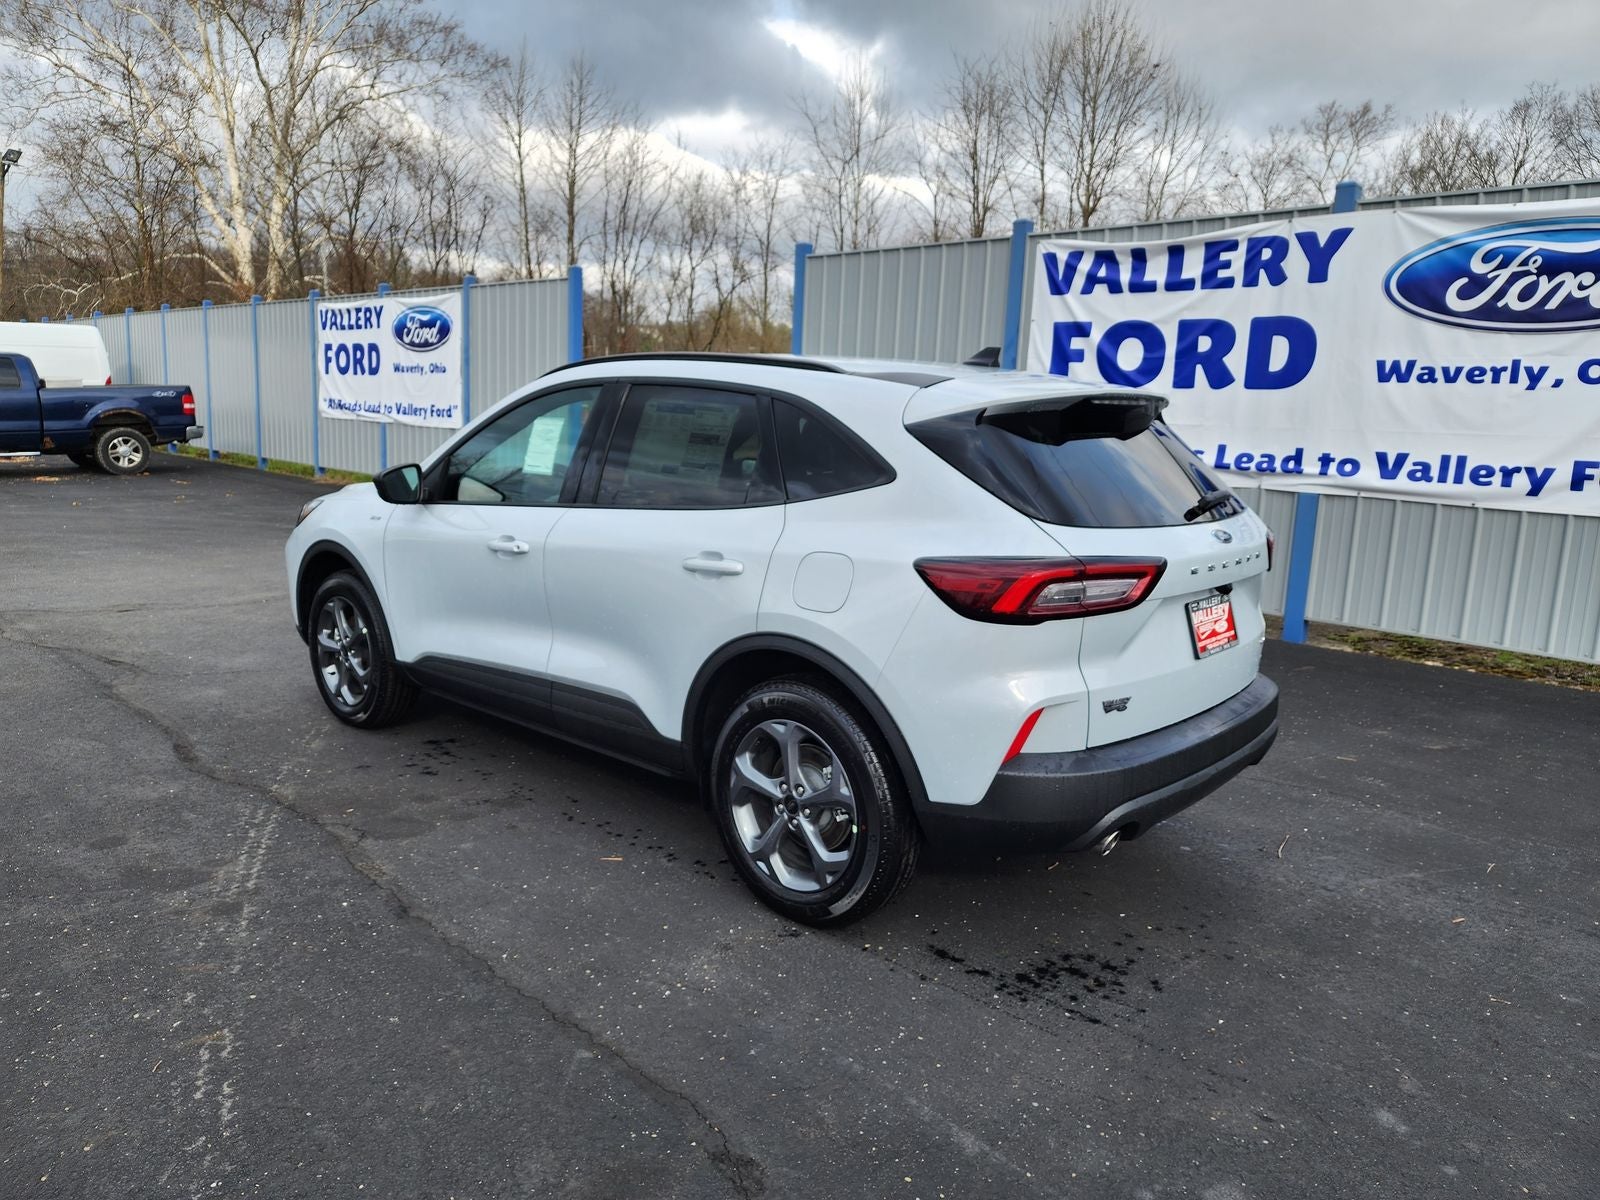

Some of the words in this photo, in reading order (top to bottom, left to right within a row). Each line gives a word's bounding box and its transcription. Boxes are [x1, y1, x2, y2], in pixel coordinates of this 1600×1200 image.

[1043, 227, 1354, 295] VALLERY
[320, 305, 384, 331] VALLERY
[403, 312, 441, 344] Ford
[324, 343, 381, 376] FORD
[429, 362, 447, 374] Ohio
[1048, 316, 1318, 390] FORD
[1376, 358, 1564, 391] Waverly,
[395, 402, 428, 420] Vallery
[1213, 444, 1304, 475] Lead
[1317, 449, 1361, 478] to
[1375, 451, 1557, 498] Vallery
